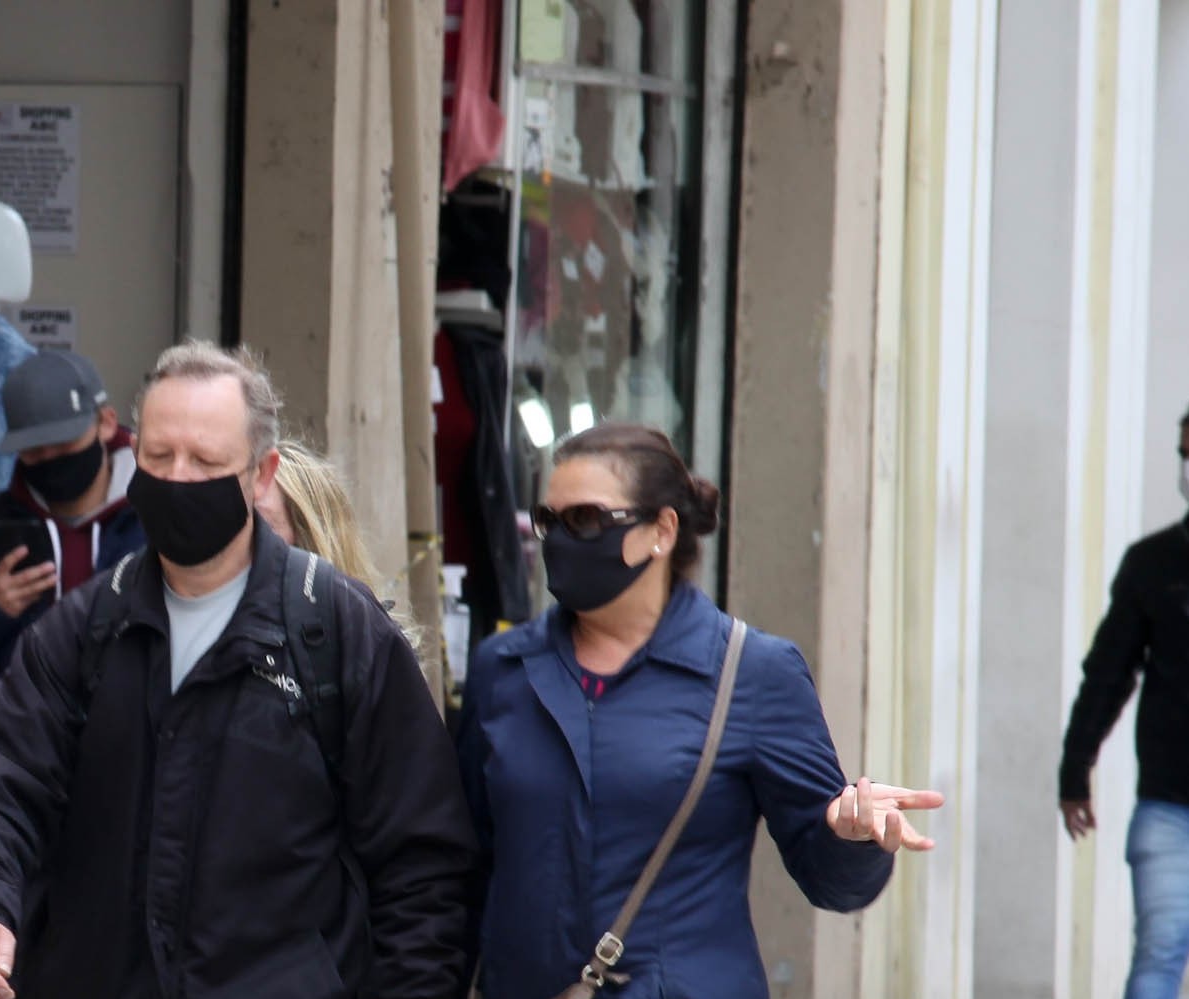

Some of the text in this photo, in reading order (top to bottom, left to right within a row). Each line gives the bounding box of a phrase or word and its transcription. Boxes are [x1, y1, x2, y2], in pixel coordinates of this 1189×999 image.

[19, 106, 72, 119] SHOPPING
[30, 121, 58, 131] ABC
[19, 309, 72, 323] SHOPPING
[30, 324, 58, 335] ABC
